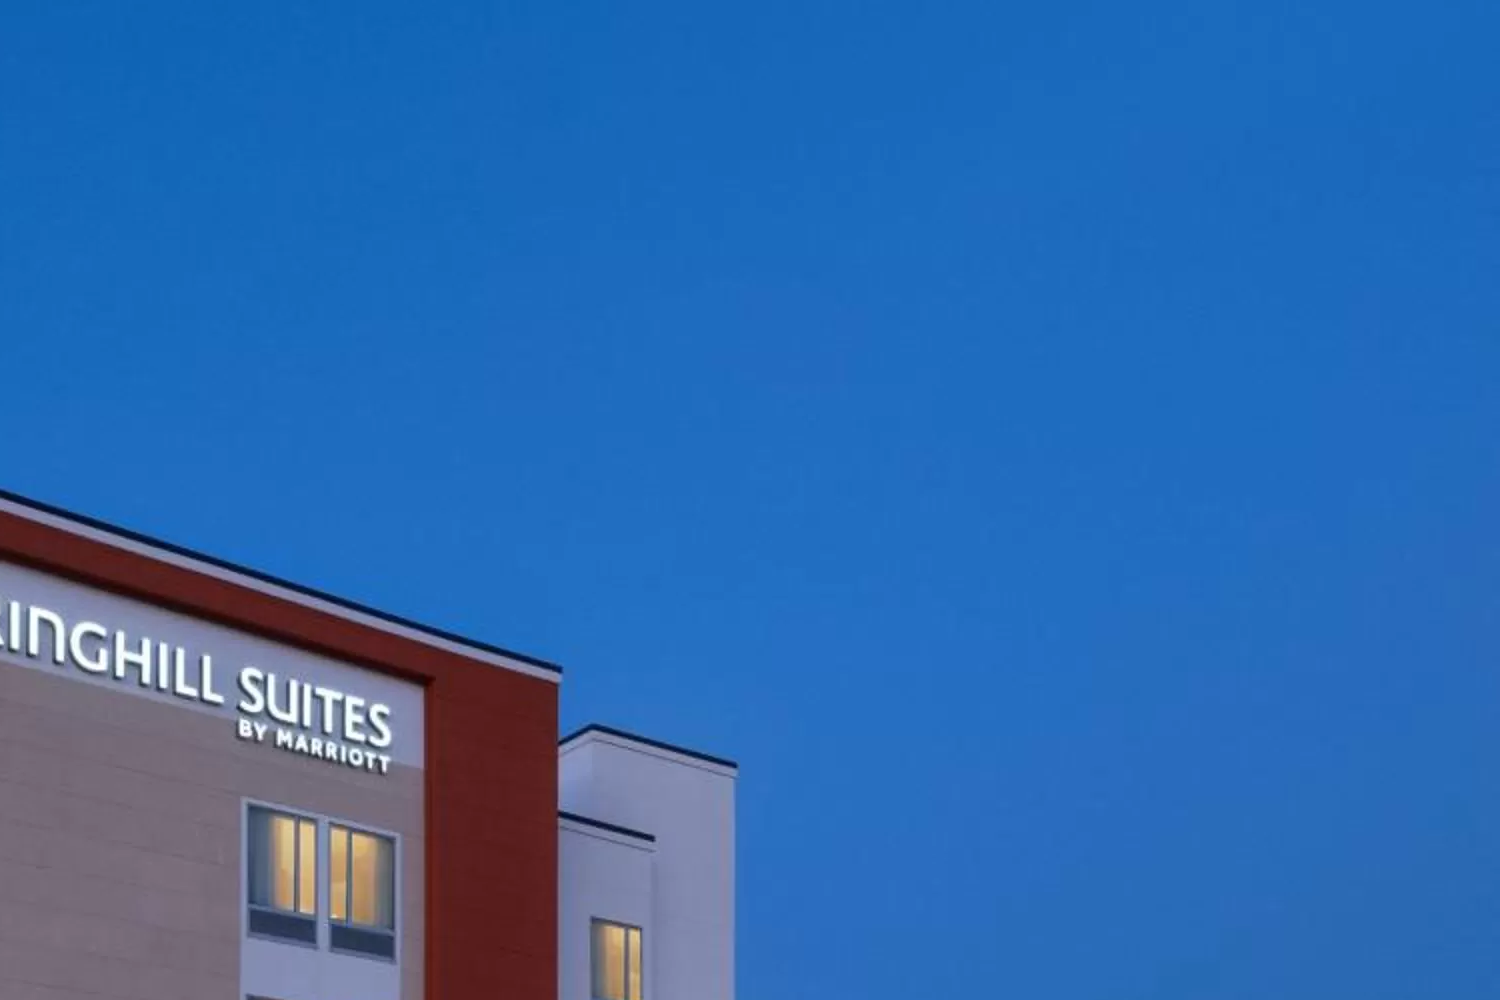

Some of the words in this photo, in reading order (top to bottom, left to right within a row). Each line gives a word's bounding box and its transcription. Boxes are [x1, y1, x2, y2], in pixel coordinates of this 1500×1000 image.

[239, 667, 392, 747] SUITES
[238, 718, 267, 741] BY
[276, 727, 392, 773] MARRIOTT
